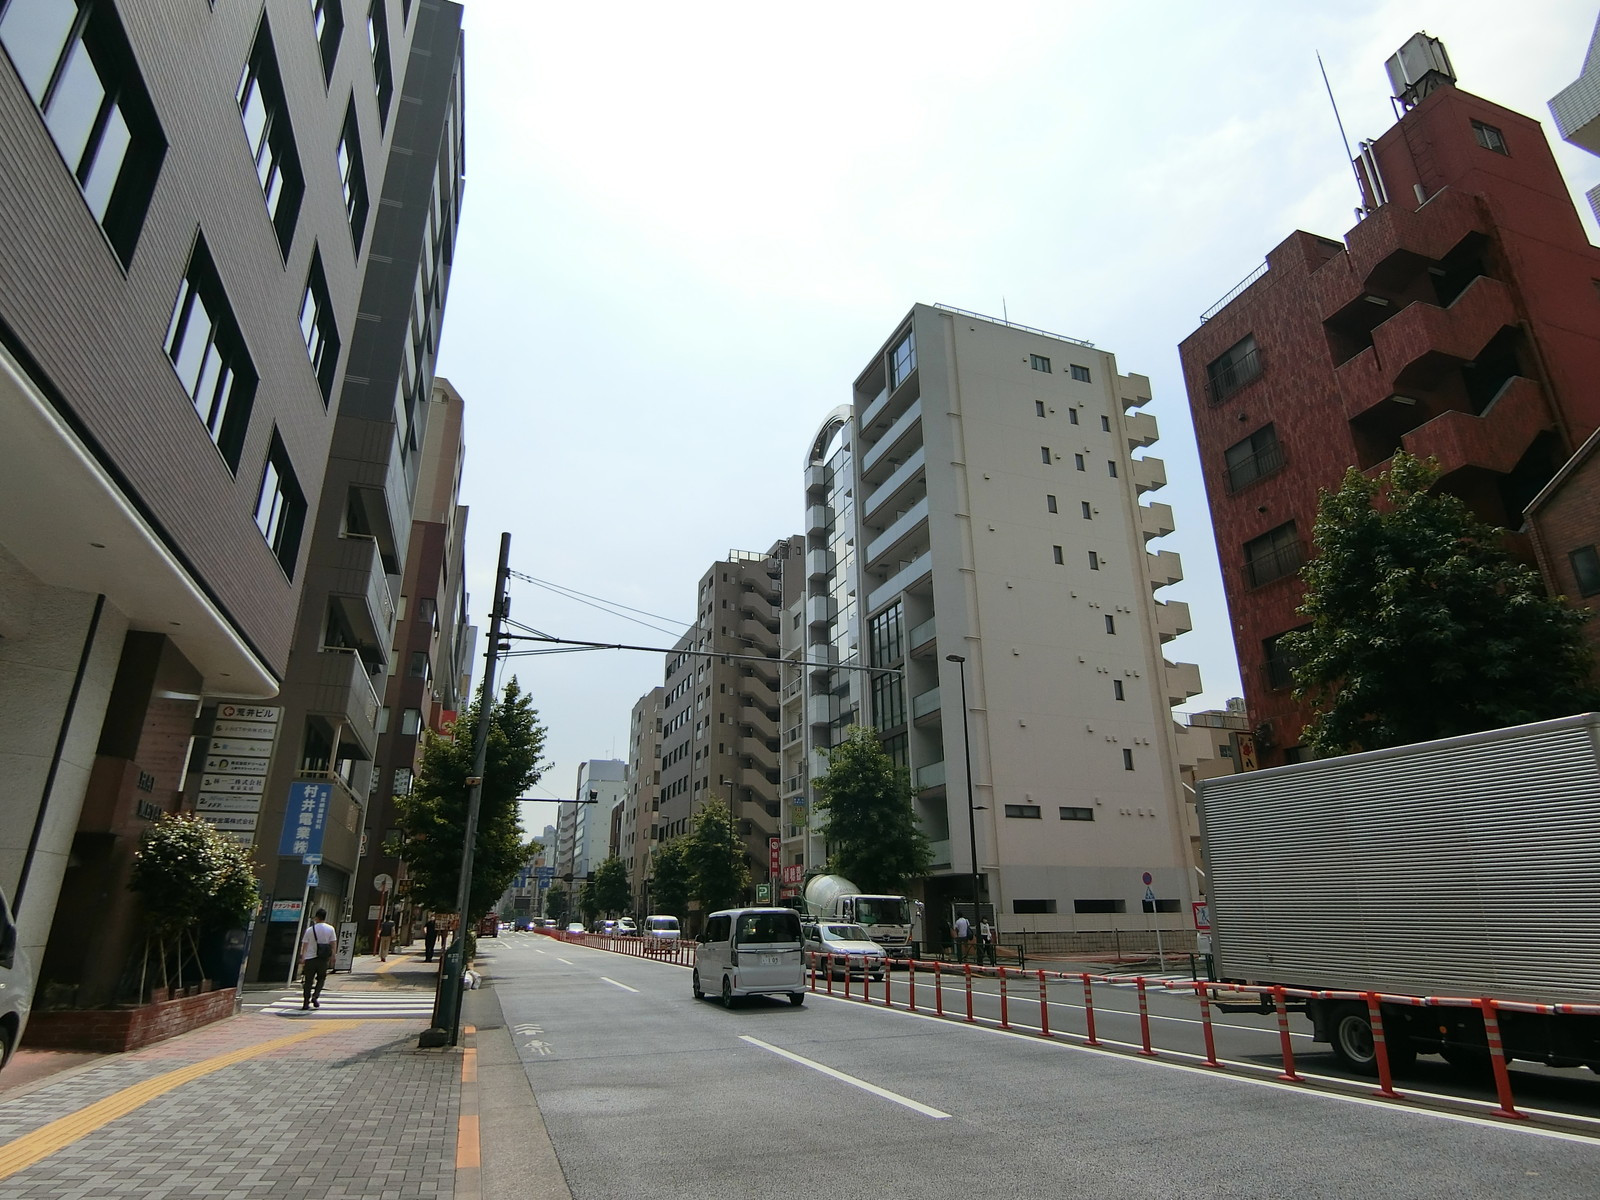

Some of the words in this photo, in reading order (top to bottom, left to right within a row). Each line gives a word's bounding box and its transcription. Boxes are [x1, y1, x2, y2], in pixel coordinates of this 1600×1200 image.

[236, 707, 274, 718] 荒井ビル
[784, 865, 802, 883] 補聴器
[759, 886, 768, 897] P
